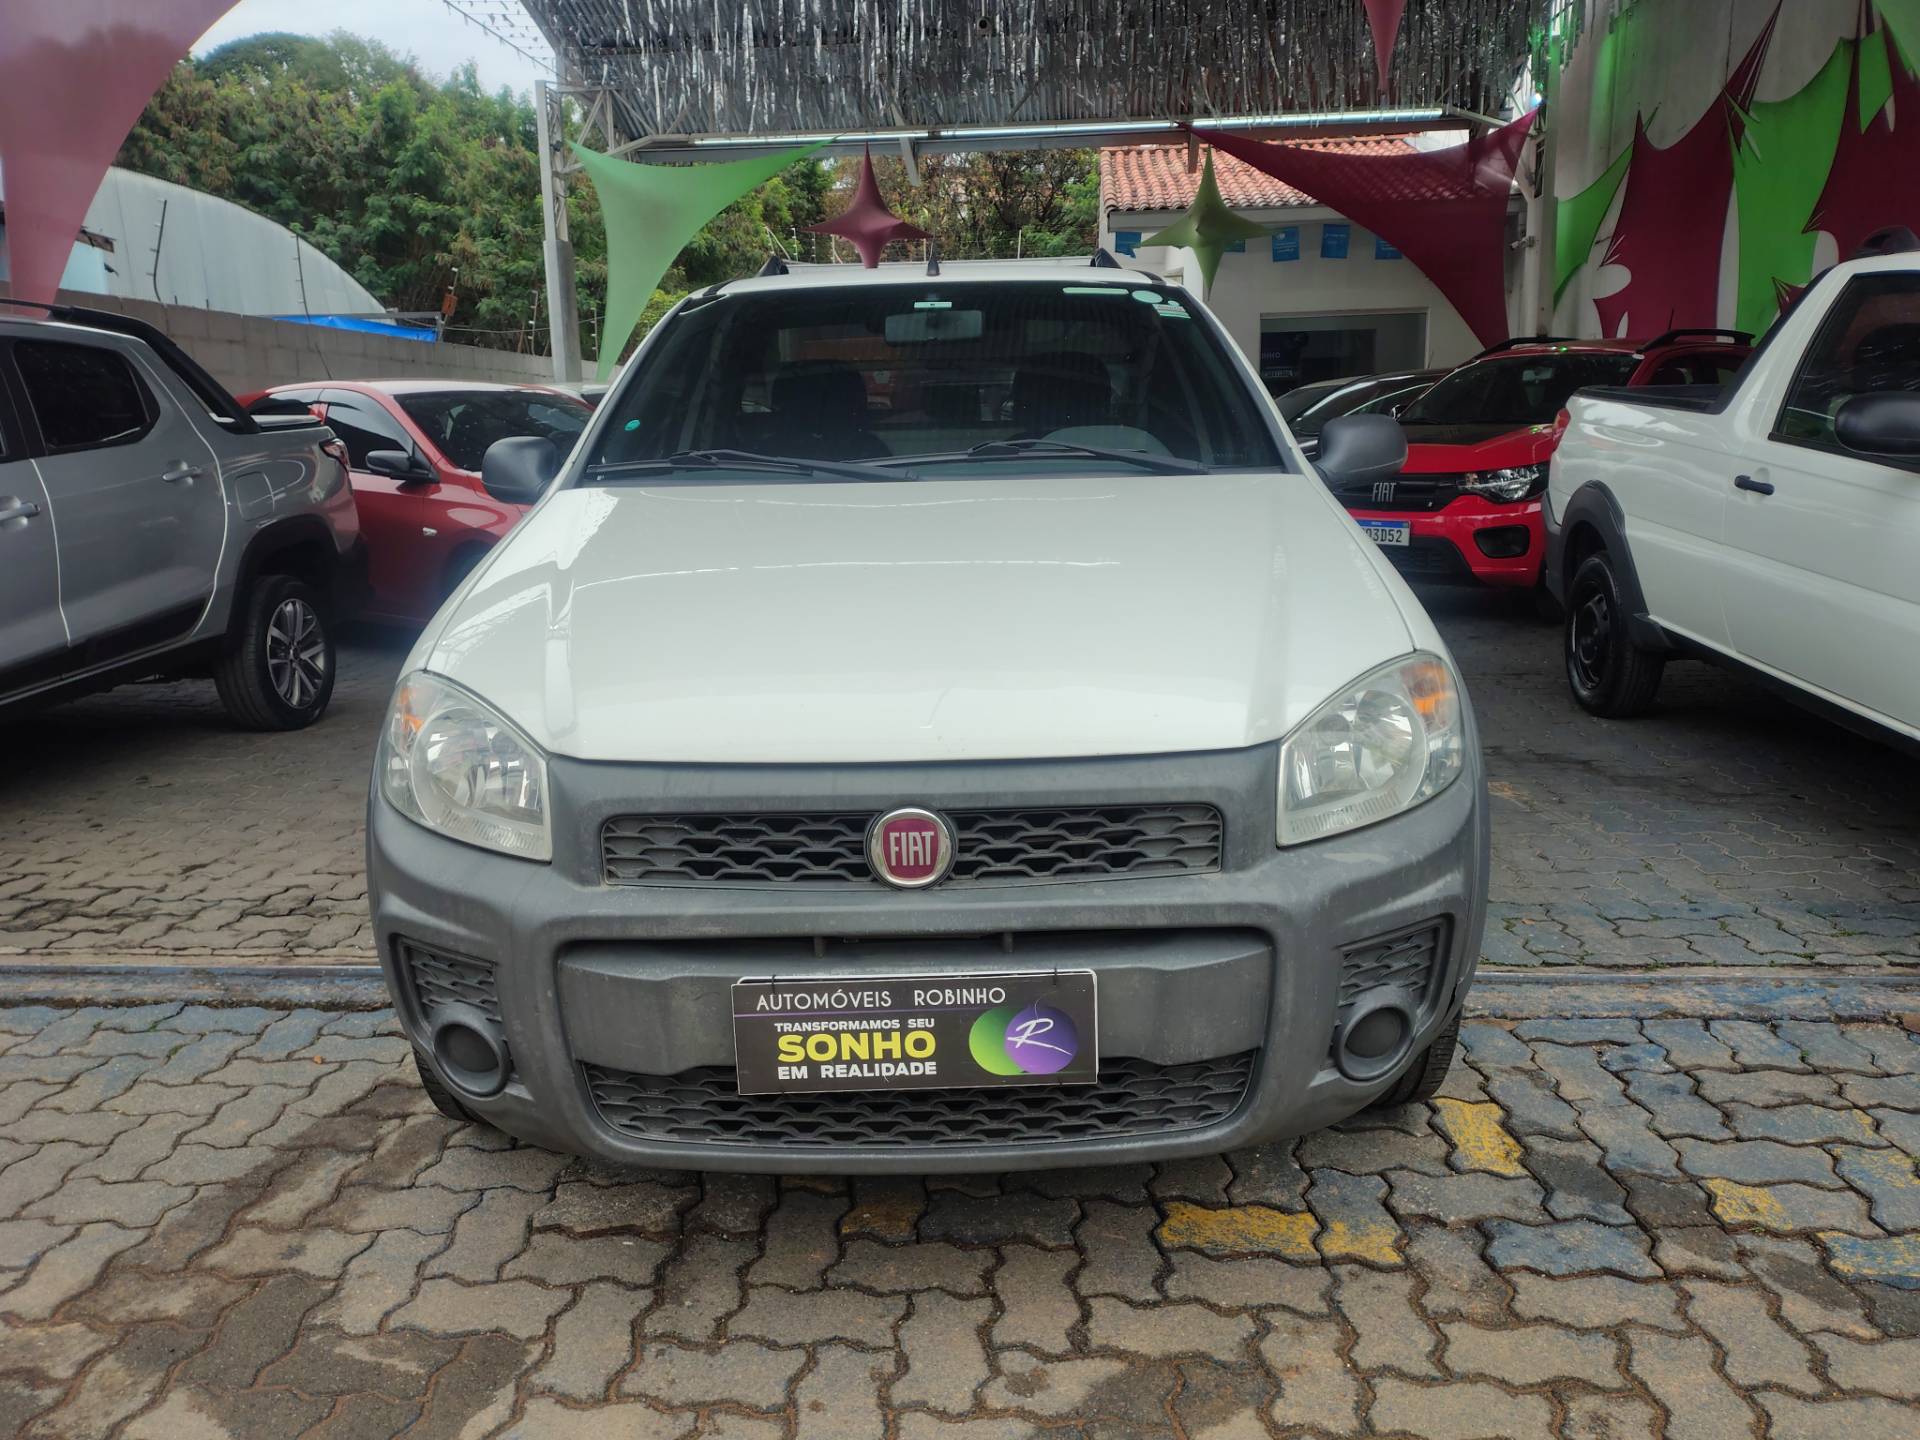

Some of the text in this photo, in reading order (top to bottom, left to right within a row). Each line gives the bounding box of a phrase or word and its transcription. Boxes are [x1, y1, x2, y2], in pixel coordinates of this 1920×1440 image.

[1372, 482, 1396, 502] FIAT
[889, 831, 934, 866] FIAT
[756, 987, 1006, 1011] AUTOMÓVEIS ROBINHO
[774, 1018, 935, 1033] TRANSFORMAMOS SEU
[777, 1030, 937, 1063] SONHO
[778, 1062, 937, 1080] EM REALIDADE
